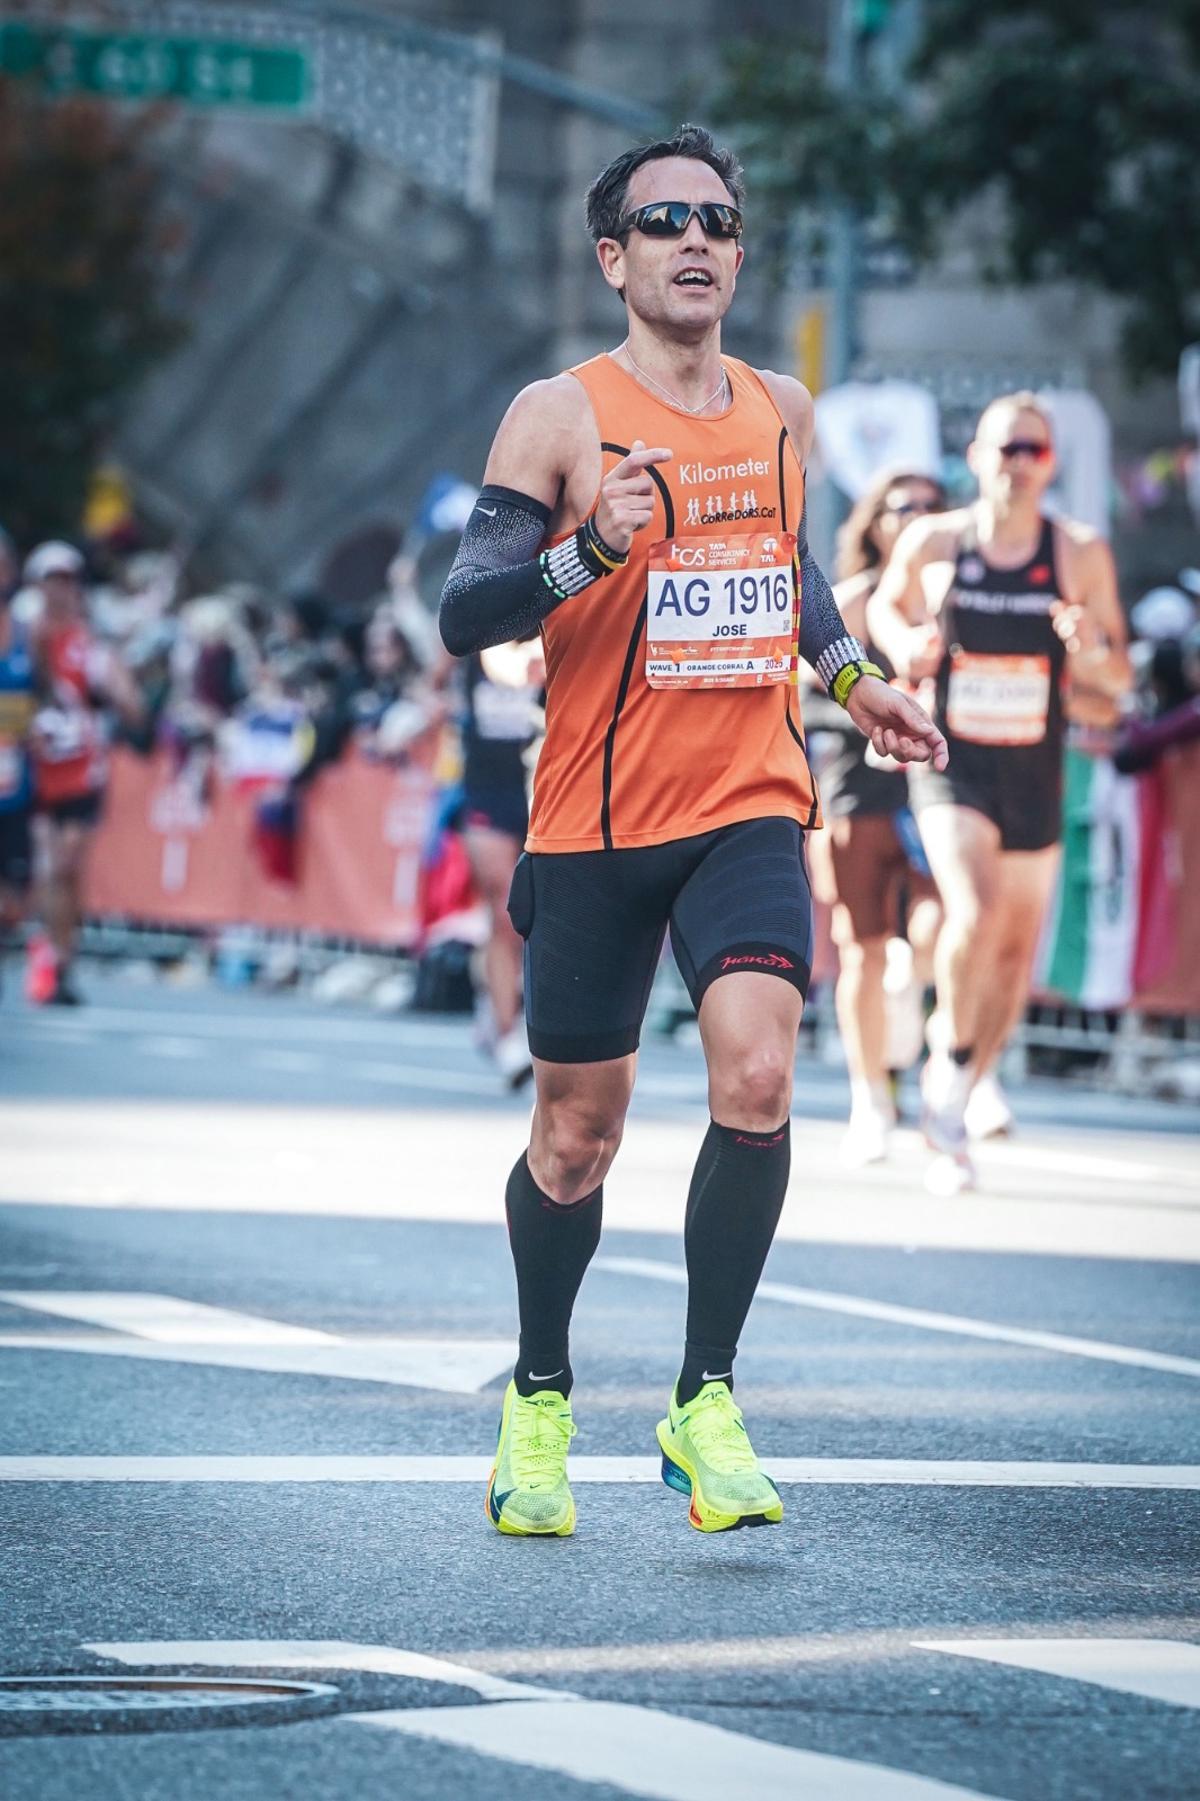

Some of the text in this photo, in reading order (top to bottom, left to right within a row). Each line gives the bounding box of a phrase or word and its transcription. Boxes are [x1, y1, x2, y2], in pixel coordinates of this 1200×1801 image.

[679, 458, 770, 485] Kilometer
[655, 573, 788, 617] AG 1916
[712, 624, 747, 637] JOSE
[649, 664, 673, 672] WAVE
[675, 663, 681, 673] 1
[687, 664, 716, 672] ORANGE
[717, 662, 744, 671] CORRAL
[746, 661, 755, 670] A
